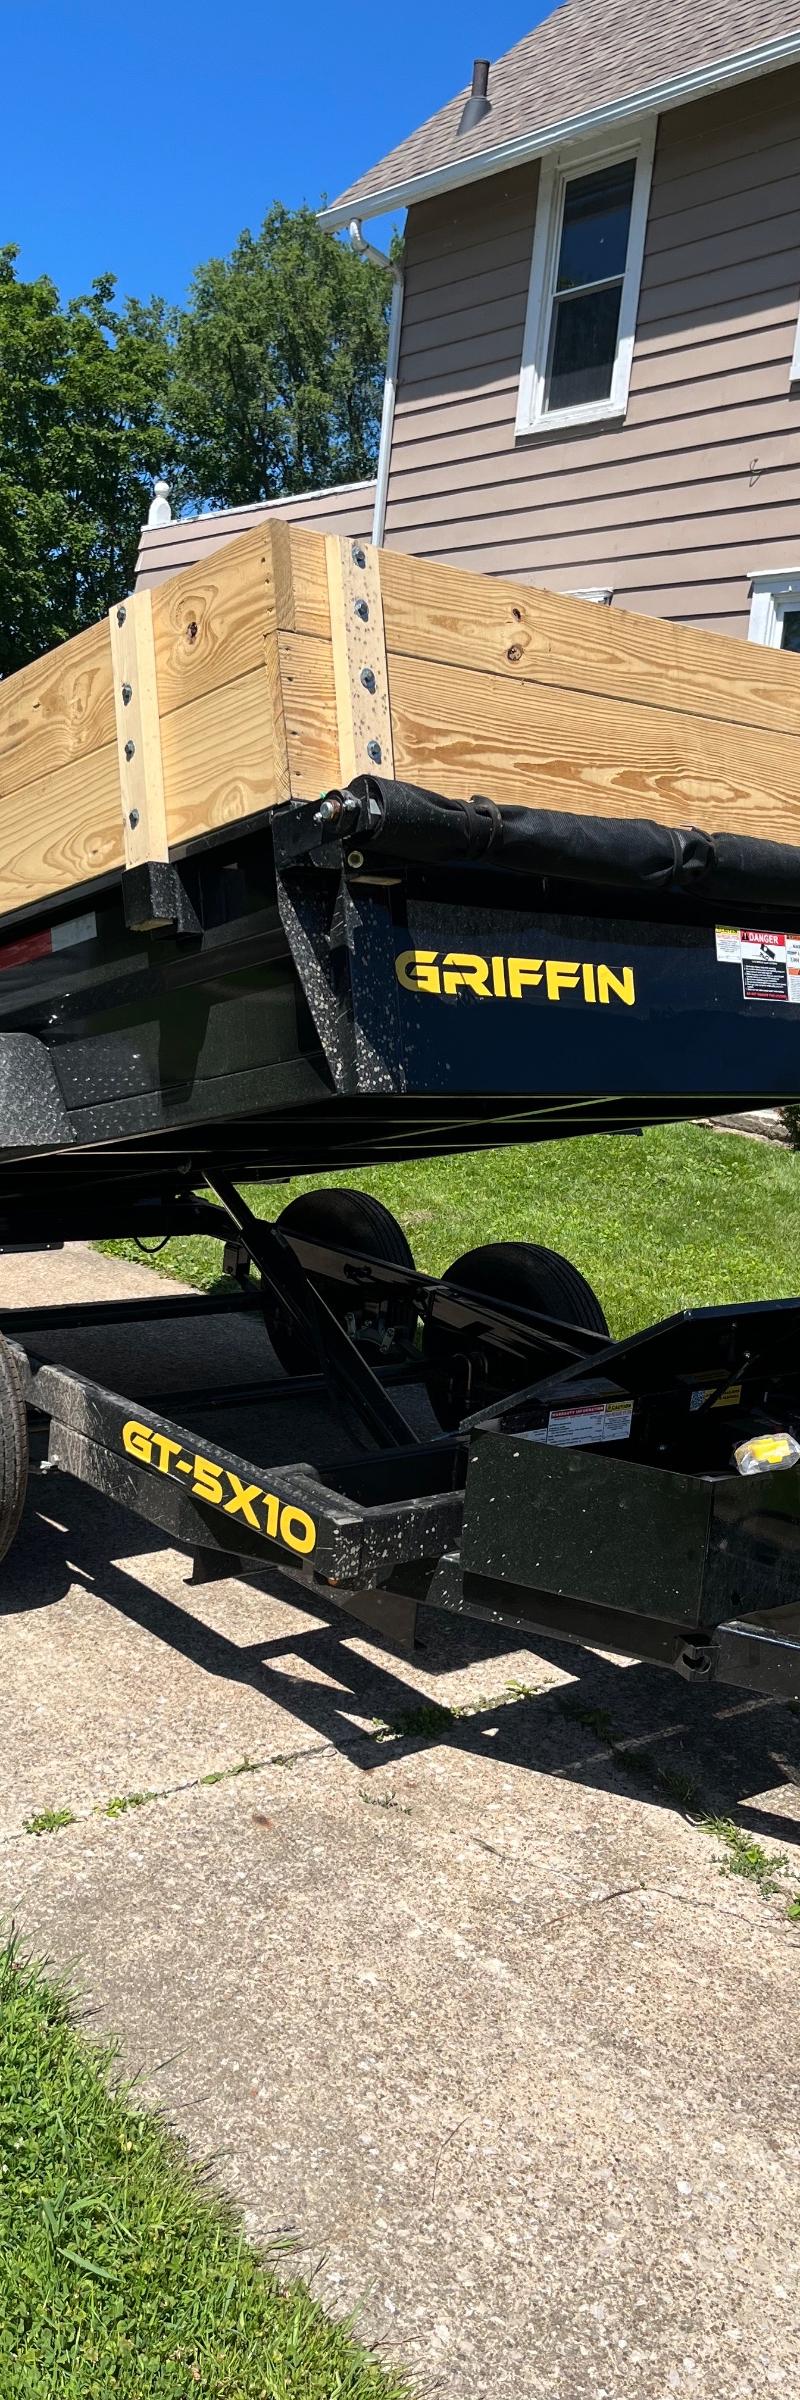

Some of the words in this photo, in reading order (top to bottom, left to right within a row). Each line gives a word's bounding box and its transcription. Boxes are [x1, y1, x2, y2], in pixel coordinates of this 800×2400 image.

[748, 932, 779, 945] DANGER
[395, 950, 635, 1005] GRIFFIN
[122, 1420, 316, 1554] GT-5X10
